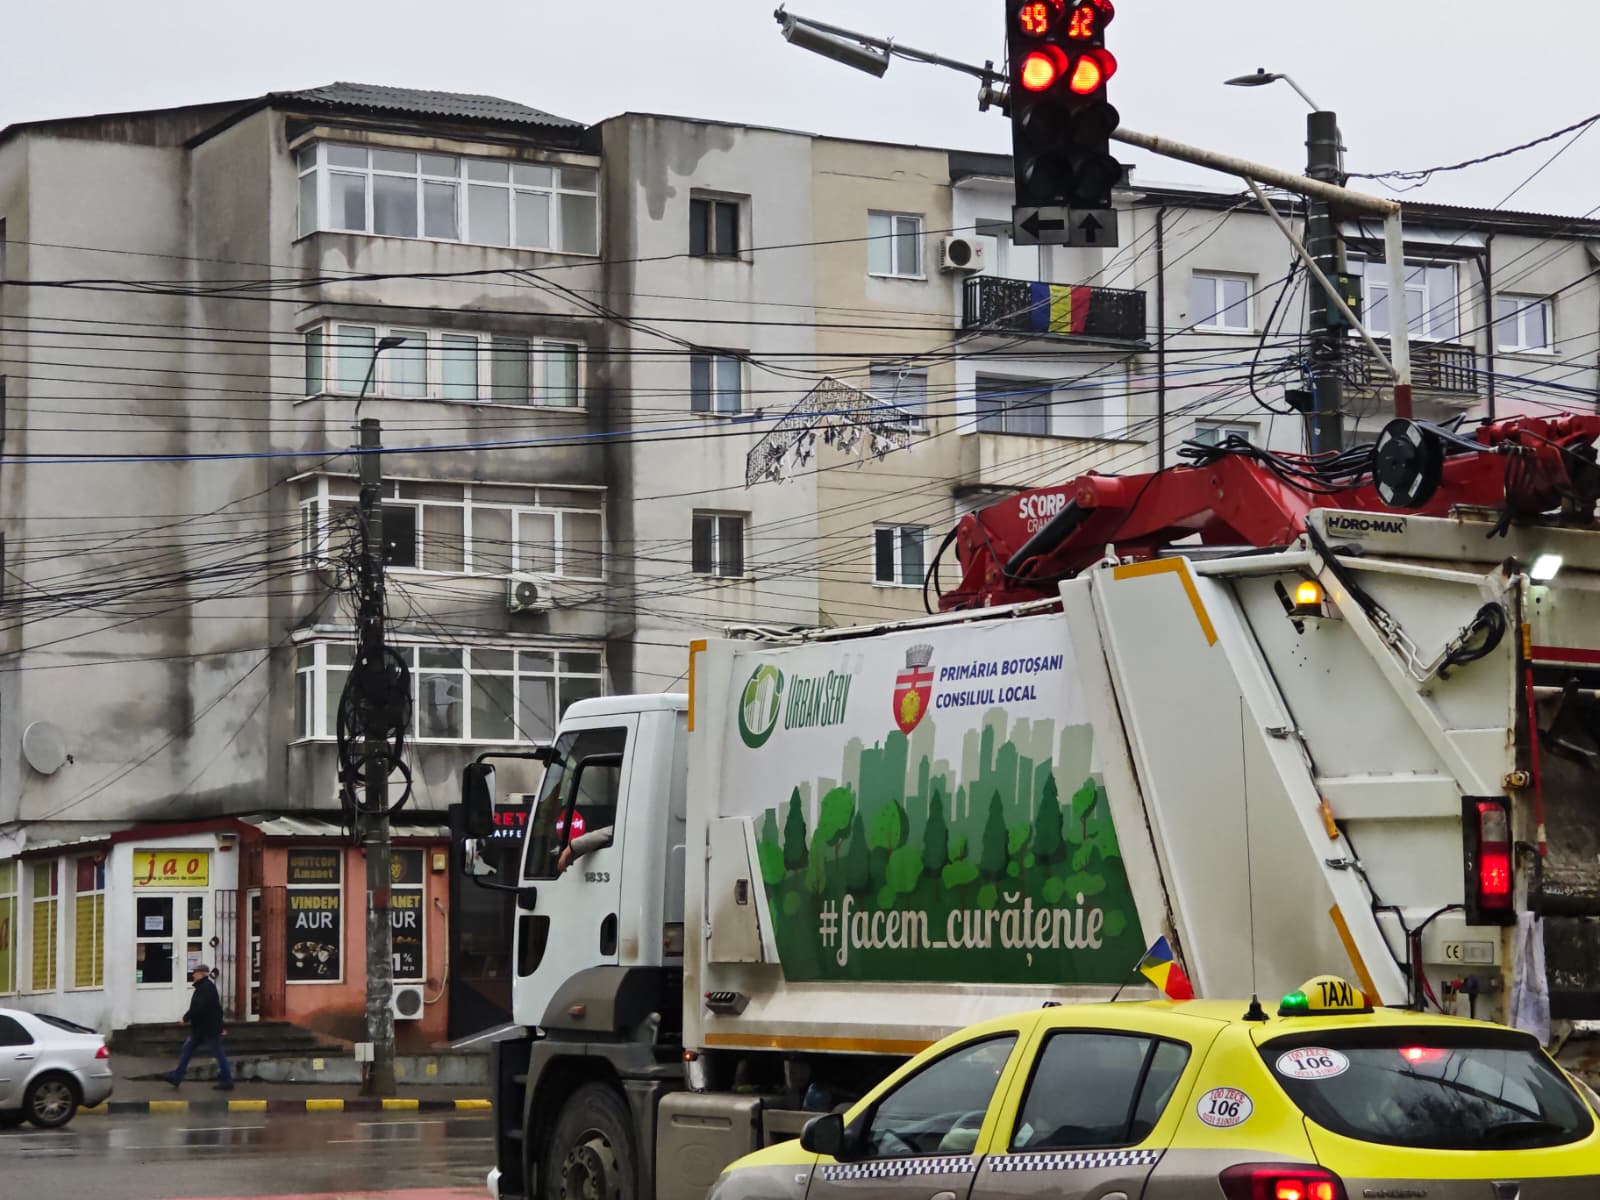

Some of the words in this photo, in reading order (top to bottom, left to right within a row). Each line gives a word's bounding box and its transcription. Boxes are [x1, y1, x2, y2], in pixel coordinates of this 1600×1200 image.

[1021, 3, 1048, 33] 49
[940, 659, 998, 682] PRIMĂRIA
[1001, 654, 1064, 677] BOTOȘANI
[936, 688, 995, 709] CONSILIUL
[998, 684, 1037, 704] LOCAL
[488, 829, 522, 839] AFFE
[291, 896, 339, 910] VINDEM
[296, 911, 333, 929] AUR
[819, 891, 1104, 968] #facem_curățenie
[1316, 981, 1353, 1007] TAXI
[1294, 1056, 1333, 1070] 106
[1208, 1099, 1240, 1117] 106
